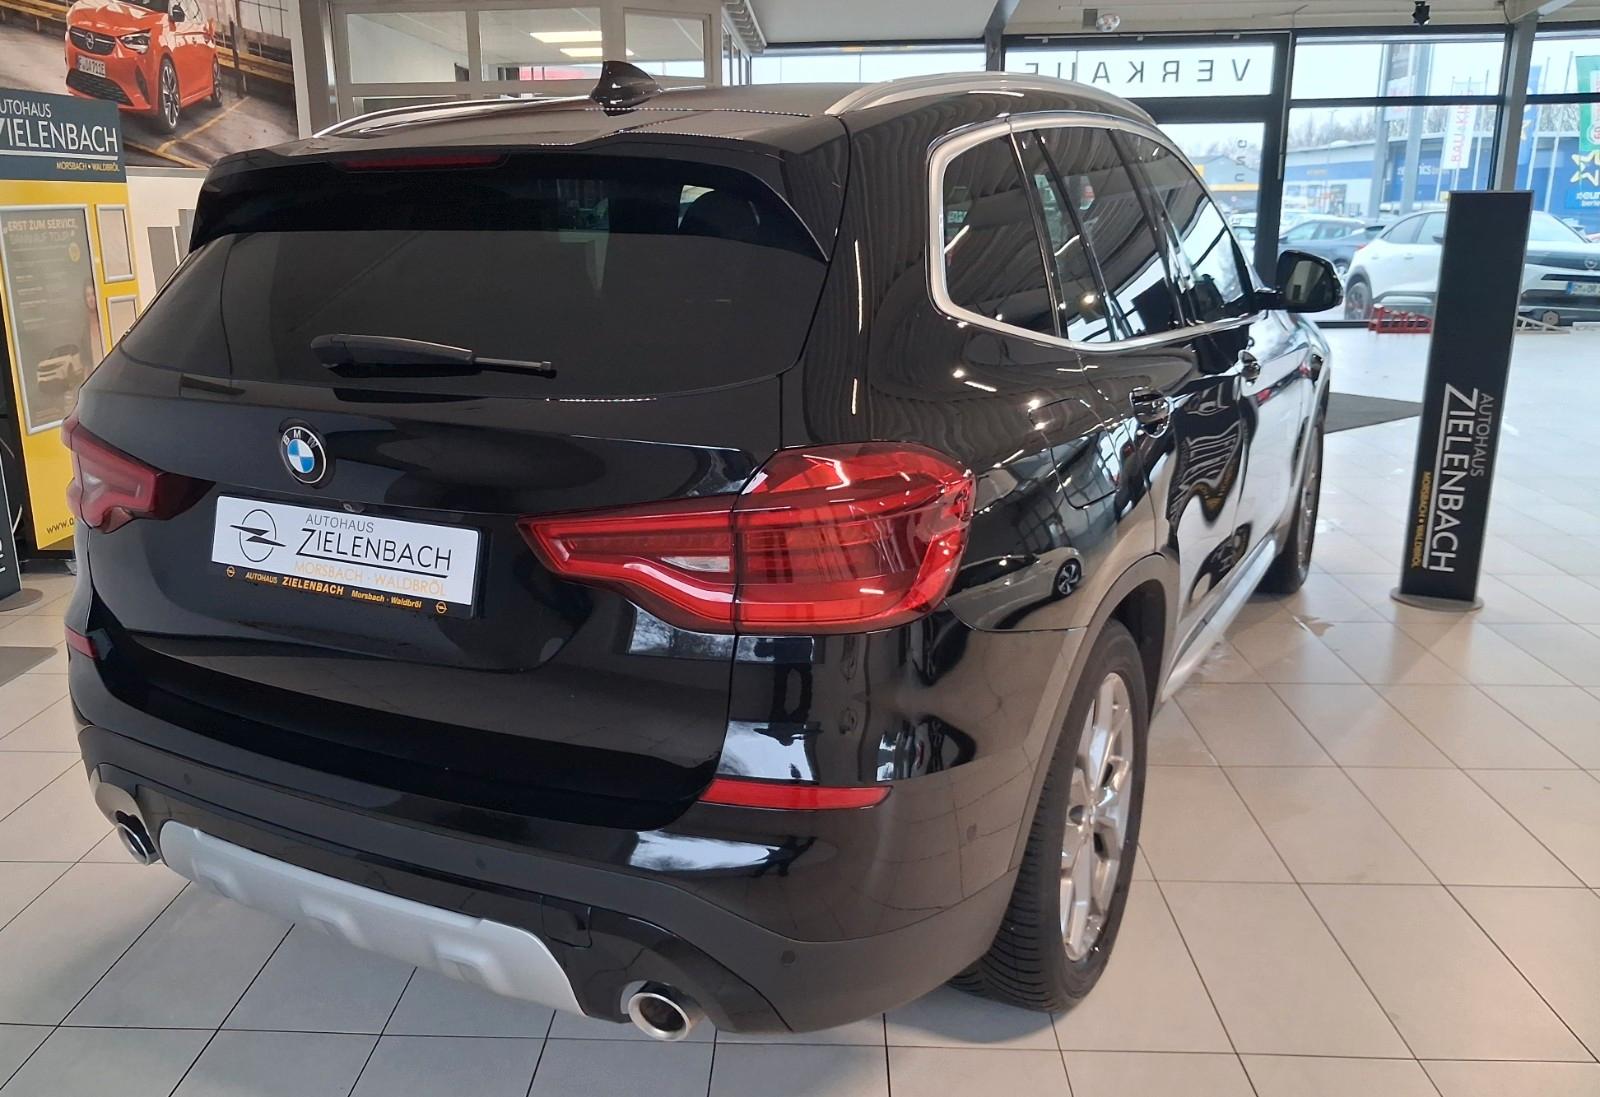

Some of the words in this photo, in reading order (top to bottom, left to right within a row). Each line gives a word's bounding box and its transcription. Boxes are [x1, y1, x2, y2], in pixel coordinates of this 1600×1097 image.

[0, 98, 51, 118] UTOHAUS
[56, 161, 87, 171] MORSBACH
[29, 219, 46, 231] ZUM
[282, 429, 319, 448] BMW
[1470, 392, 1495, 477] AUTOHAUS
[1418, 471, 1432, 518] MORSBACH
[1428, 383, 1479, 572] ZIELENBACH
[306, 513, 374, 534] AUTOHAUS
[296, 527, 452, 571] ZIELENBACH
[245, 571, 278, 584] AUTOHAUS
[282, 576, 344, 596] ZIELENBACH
[351, 589, 385, 603] Morsbach
[391, 596, 422, 609] Waldbröl
[295, 562, 363, 582] MORSBACH
[375, 573, 447, 597] WALDBRÖL
